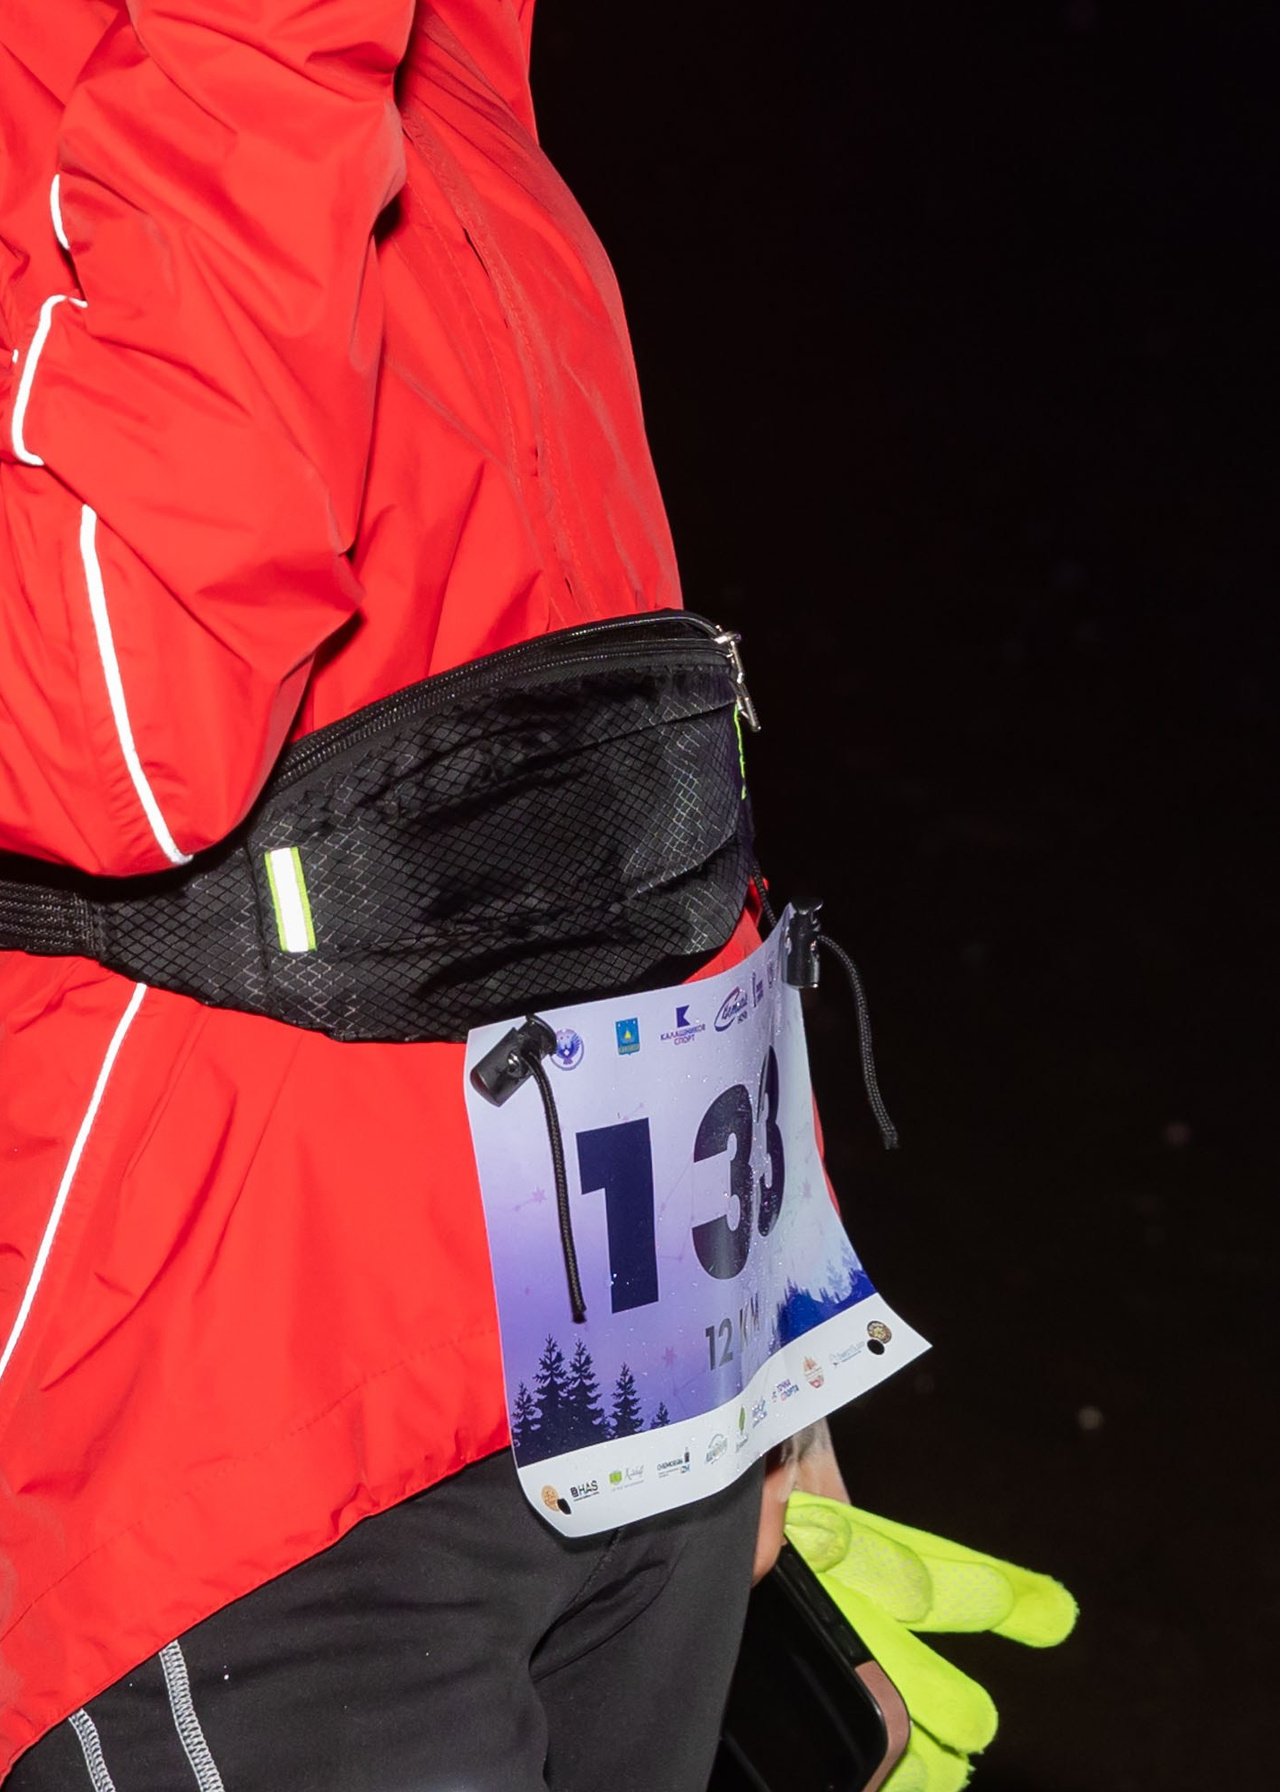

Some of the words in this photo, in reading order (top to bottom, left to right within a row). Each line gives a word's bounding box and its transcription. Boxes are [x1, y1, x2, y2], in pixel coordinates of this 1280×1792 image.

[660, 1024, 707, 1042] КАЛАШНИКОВ
[673, 1034, 696, 1047] СПОРТ
[705, 1318, 734, 1372] 12
